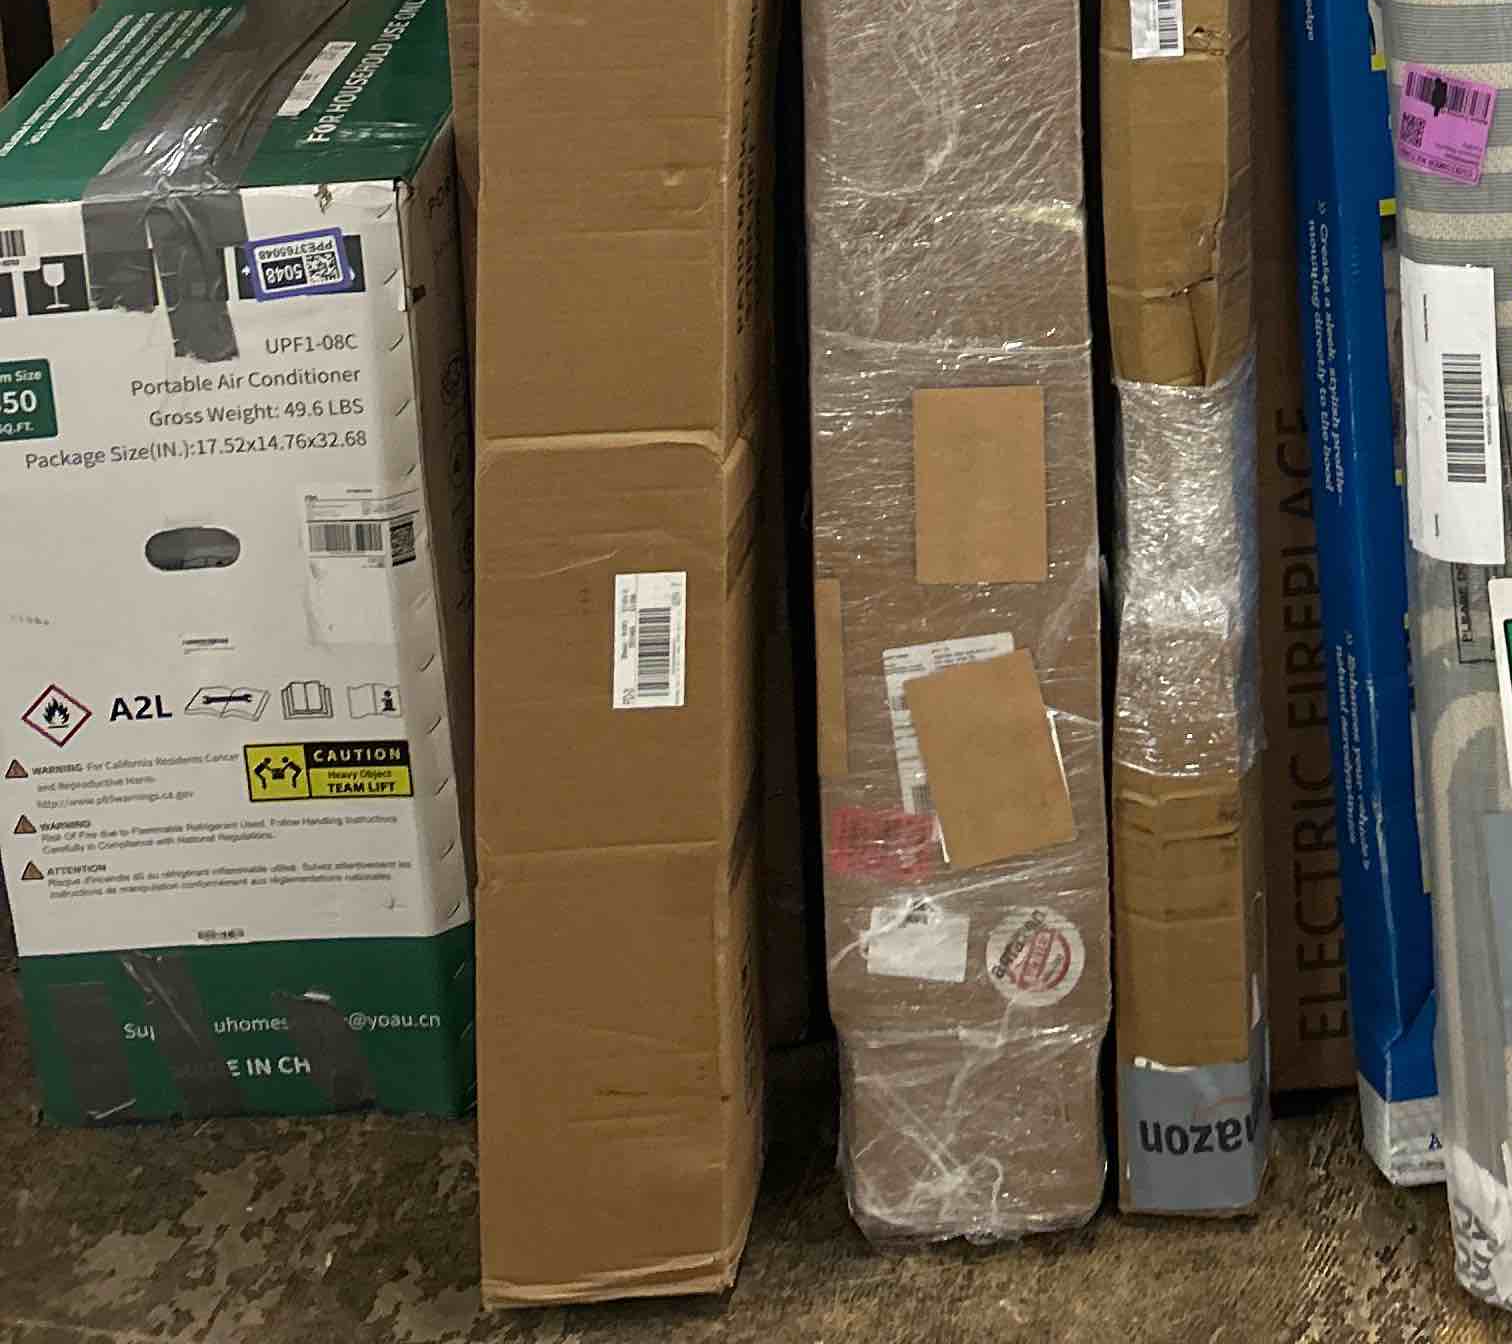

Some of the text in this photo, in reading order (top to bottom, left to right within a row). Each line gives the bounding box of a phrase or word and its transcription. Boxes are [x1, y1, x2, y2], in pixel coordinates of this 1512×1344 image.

[308, 113, 343, 144] FOR
[338, 39, 396, 117] HOUSEHOLD
[384, 13, 409, 44] USE
[258, 239, 333, 261] PPE3765048
[264, 265, 304, 286] 5048
[265, 333, 358, 354] UPF1-08C
[15, 369, 42, 382] Size
[131, 368, 361, 396] Portable Air Conditioner
[0, 390, 38, 413] 50
[149, 398, 365, 427] Gross Weight: 49.6 LBS
[25, 449, 106, 470] Package
[110, 694, 173, 723] A2L
[1278, 412, 1350, 1043] ELECTRIC FIREPLACE
[313, 748, 400, 762] CAUTION
[328, 768, 392, 781] Heavy Object
[328, 781, 396, 793] TEAM LIFT
[246, 1055, 312, 1077] IN CH
